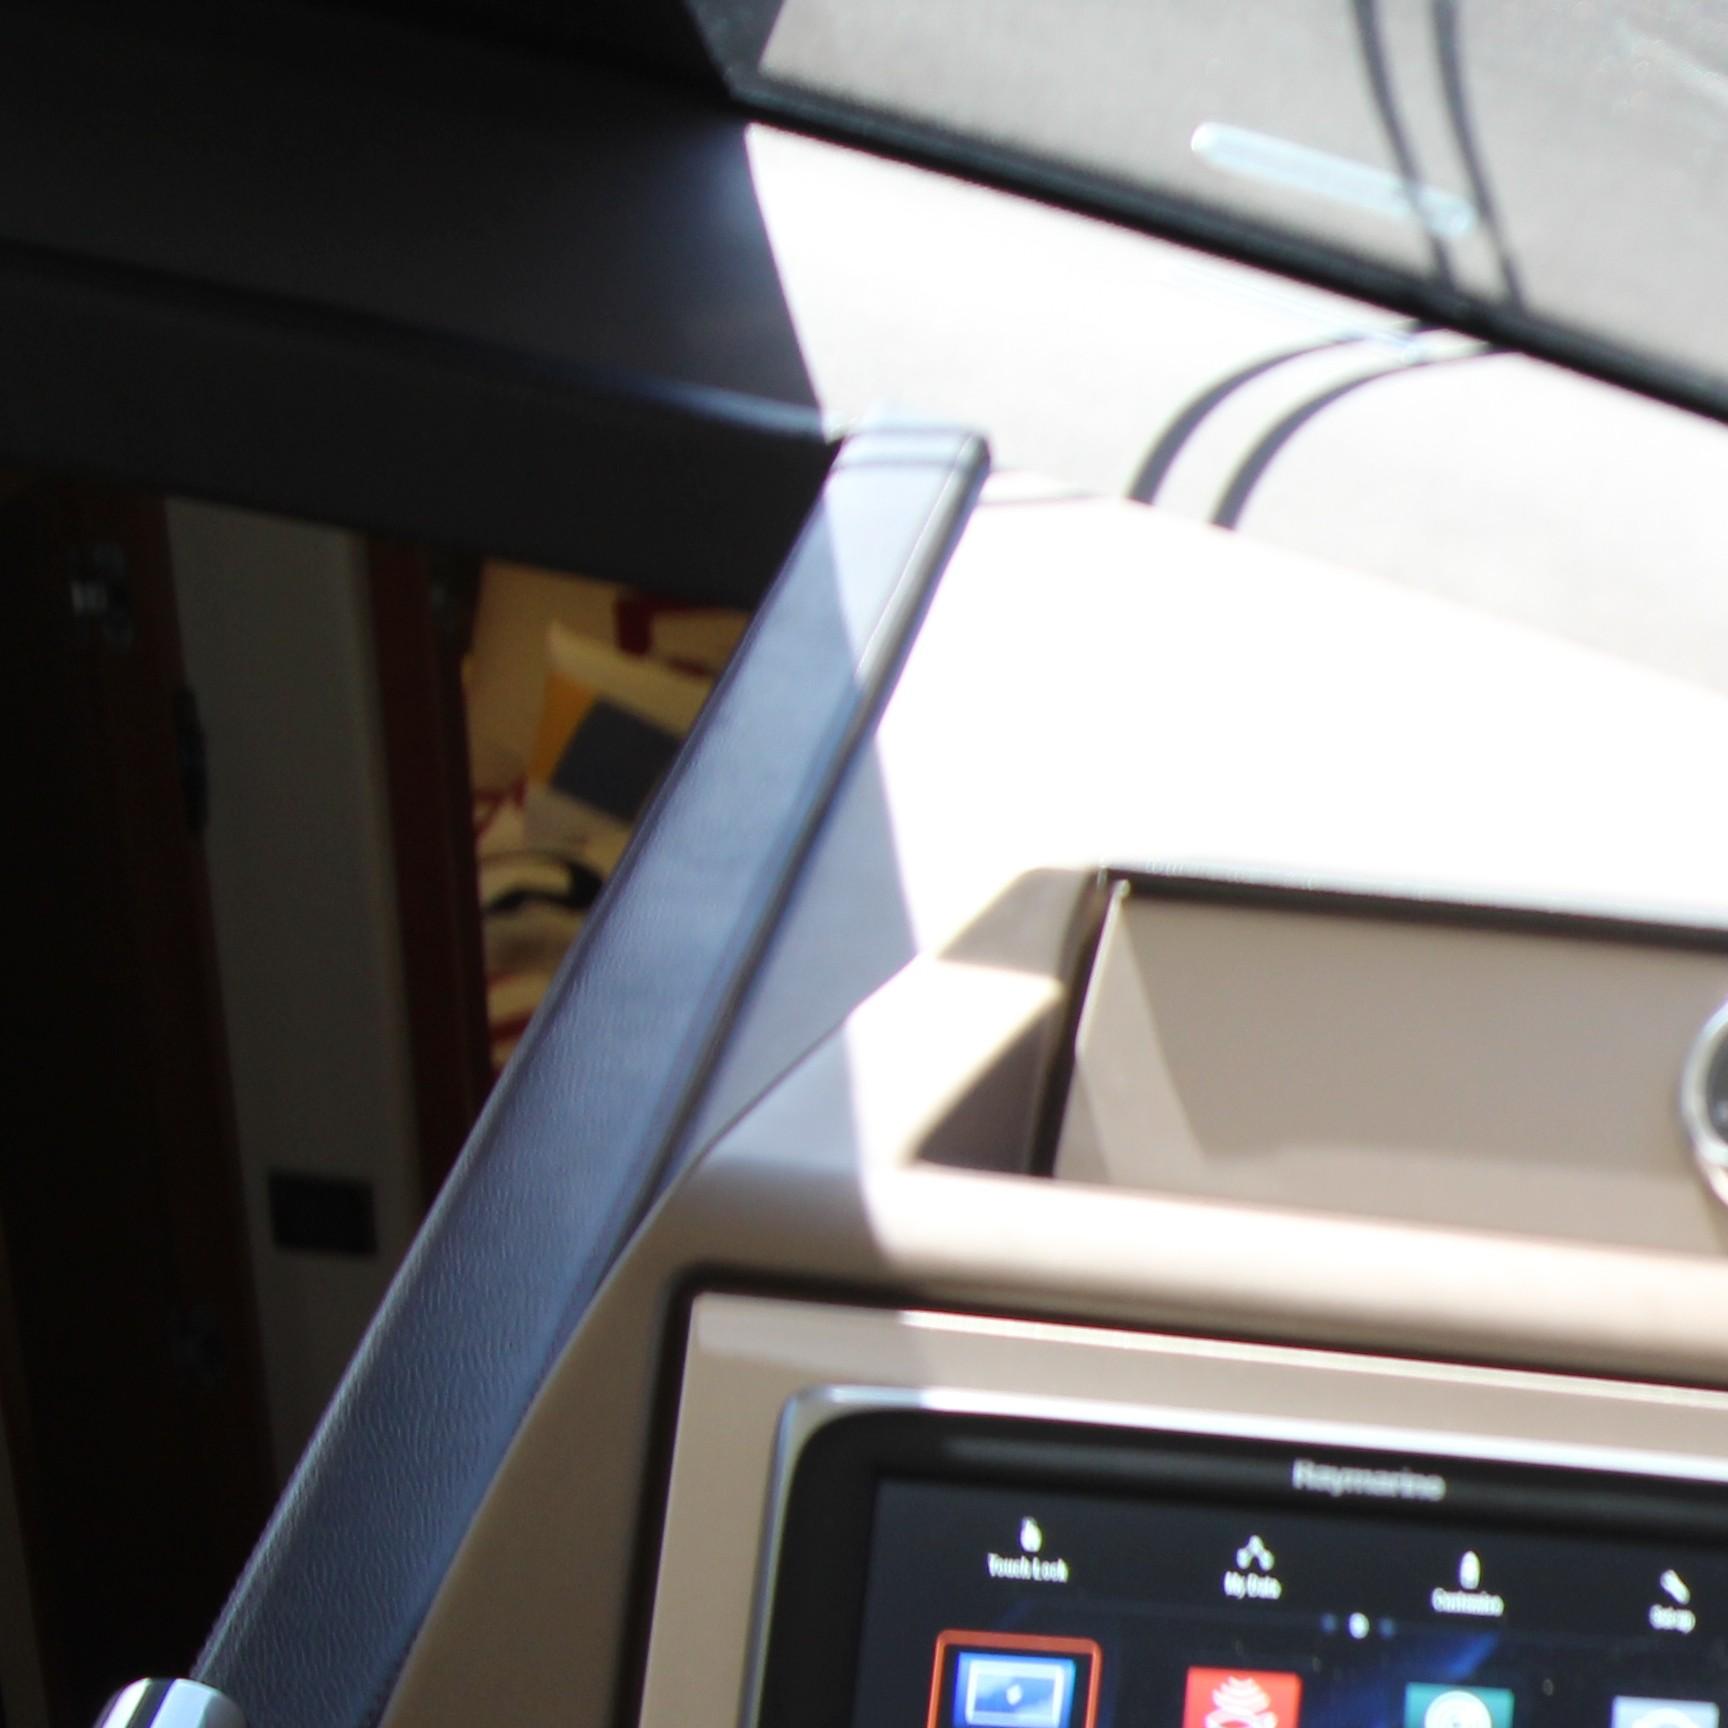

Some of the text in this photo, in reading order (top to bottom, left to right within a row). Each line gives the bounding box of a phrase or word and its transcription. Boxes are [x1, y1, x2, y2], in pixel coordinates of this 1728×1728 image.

[1292, 1457, 1447, 1502] Raymarine
[987, 1553, 1068, 1583] Touch Lock
